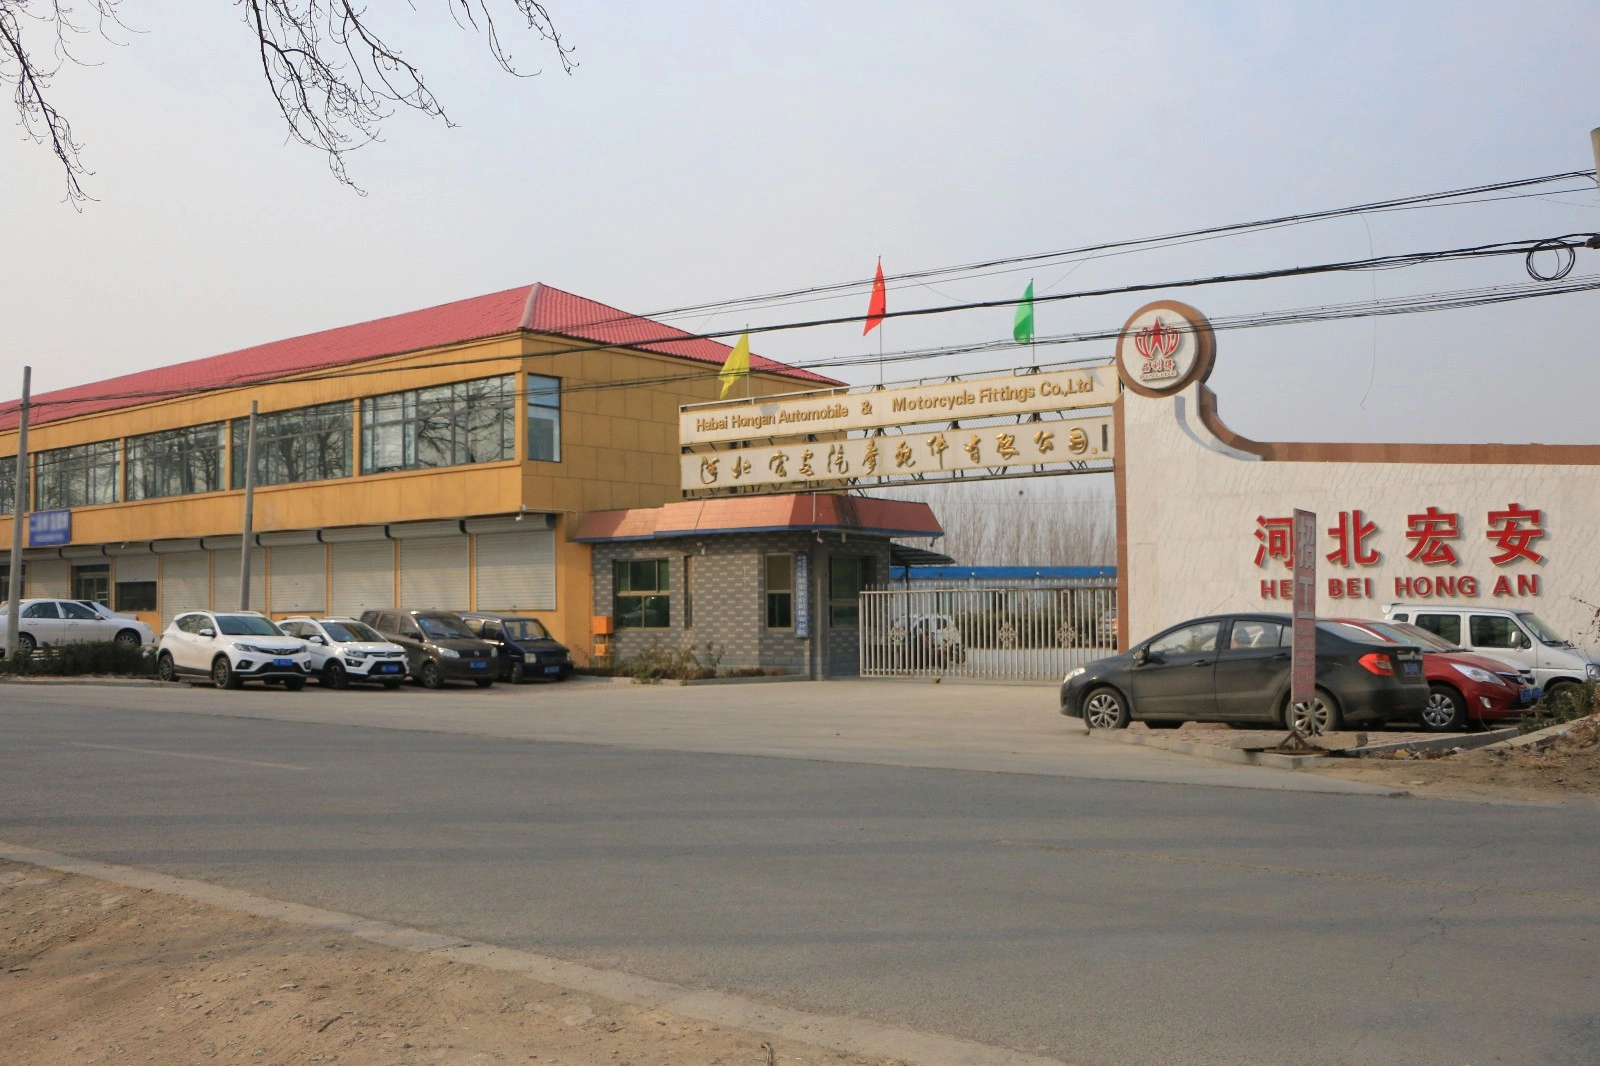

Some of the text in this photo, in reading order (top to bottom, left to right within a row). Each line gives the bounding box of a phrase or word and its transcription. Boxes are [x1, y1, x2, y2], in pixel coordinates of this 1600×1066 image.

[696, 376, 1094, 432] Hebei Hongan Automobile & Motorcycle Fittings Co.,Ltd
[1253, 503, 1544, 569] 河北宏安
[1260, 574, 1539, 600] HE BEI HONG AN
